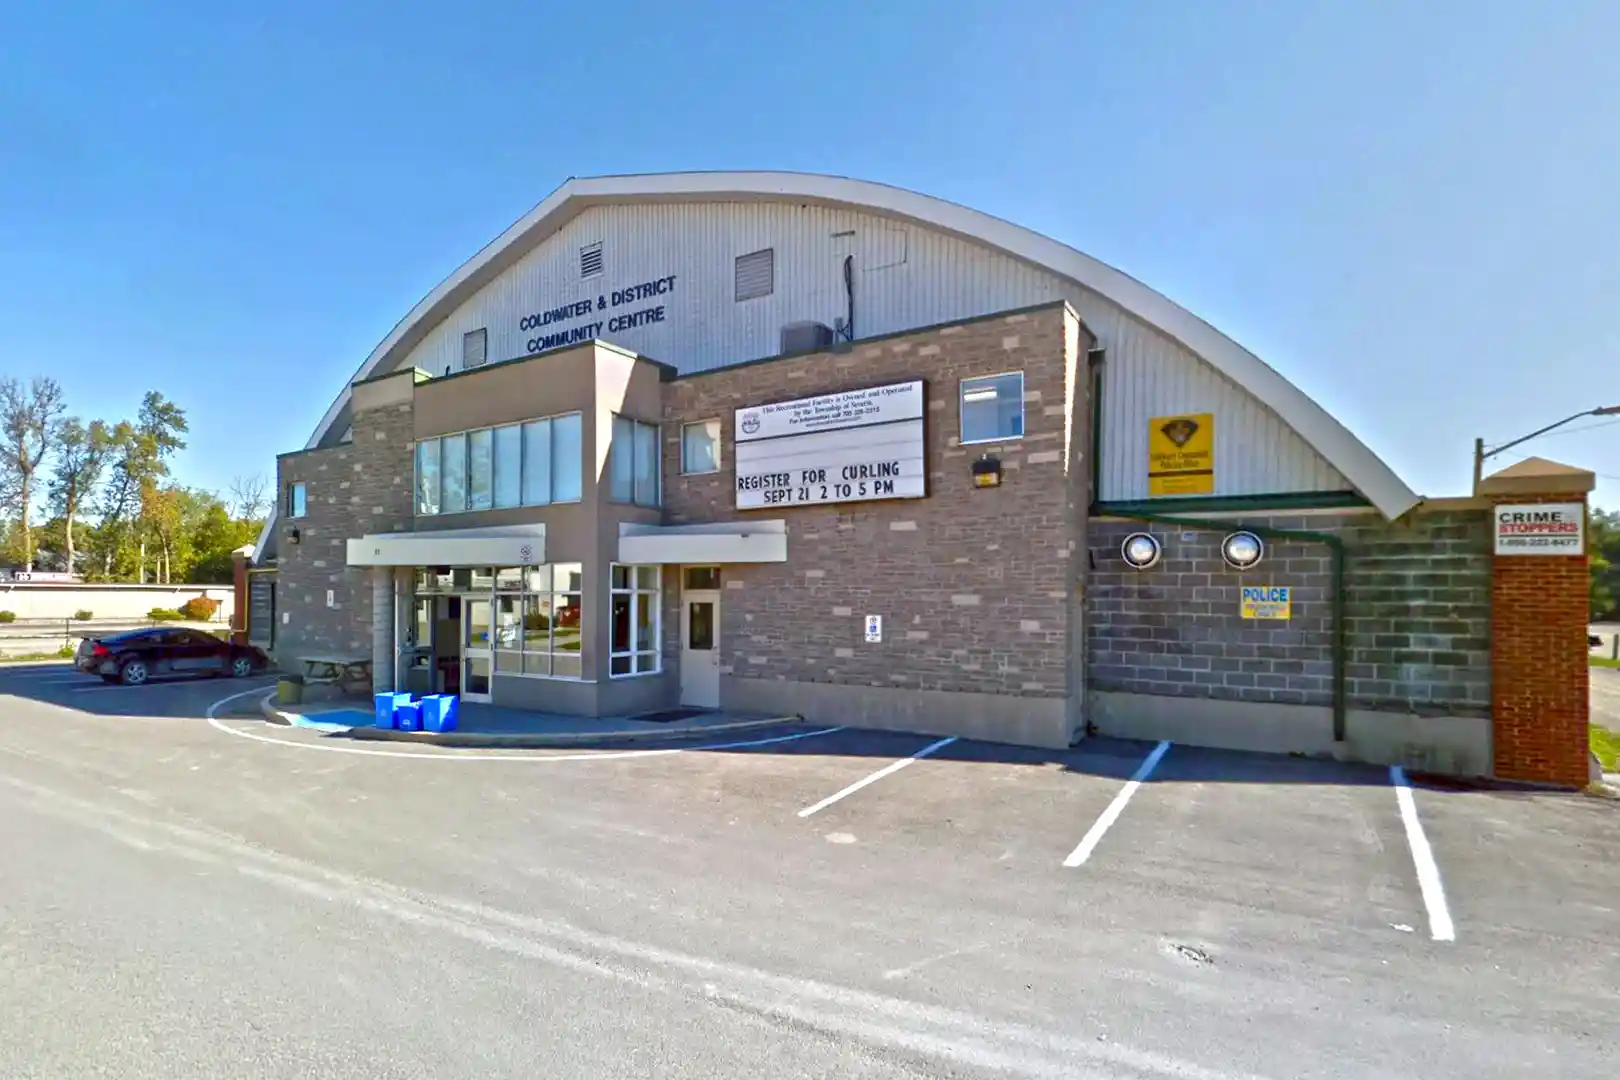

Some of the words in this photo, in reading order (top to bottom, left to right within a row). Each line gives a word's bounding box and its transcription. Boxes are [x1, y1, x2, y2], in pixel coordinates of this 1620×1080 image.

[520, 300, 592, 332] COLDWATER
[597, 295, 607, 310] &
[611, 275, 676, 307] DISTRICT
[527, 322, 603, 353] COMMUNITY
[608, 306, 665, 333] CENTRE
[842, 391, 866, 402] Owned
[881, 384, 912, 396] Operated
[738, 472, 790, 491] REGISTER
[802, 468, 826, 485] FOR
[842, 461, 899, 480] CURLING
[763, 488, 792, 503] SEPT
[797, 487, 809, 501] 21
[820, 485, 828, 499] 2
[833, 483, 852, 498] TO
[858, 481, 867, 496] 5
[874, 480, 894, 495] PM
[1499, 511, 1563, 523] CRIME
[1243, 588, 1289, 603] POLICE
